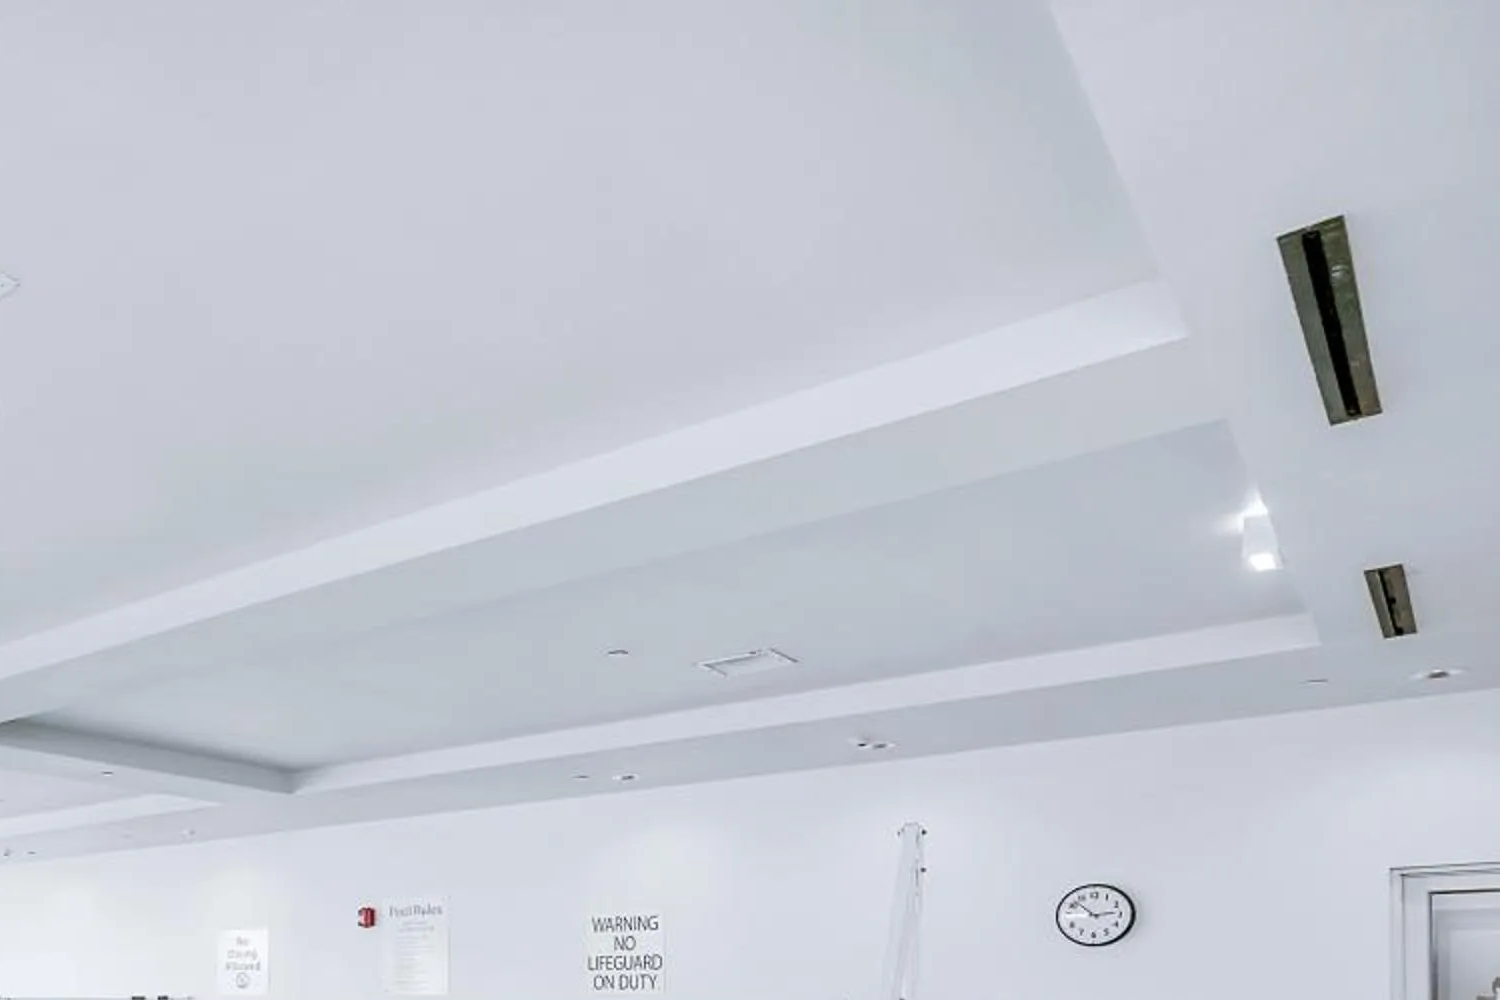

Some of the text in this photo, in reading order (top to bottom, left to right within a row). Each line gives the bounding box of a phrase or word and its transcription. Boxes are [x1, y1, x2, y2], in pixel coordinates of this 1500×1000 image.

[591, 915, 659, 933] WARNING
[614, 935, 636, 951] NO
[587, 954, 663, 971] LIFEGUARD
[593, 974, 657, 991] ON DUTY
